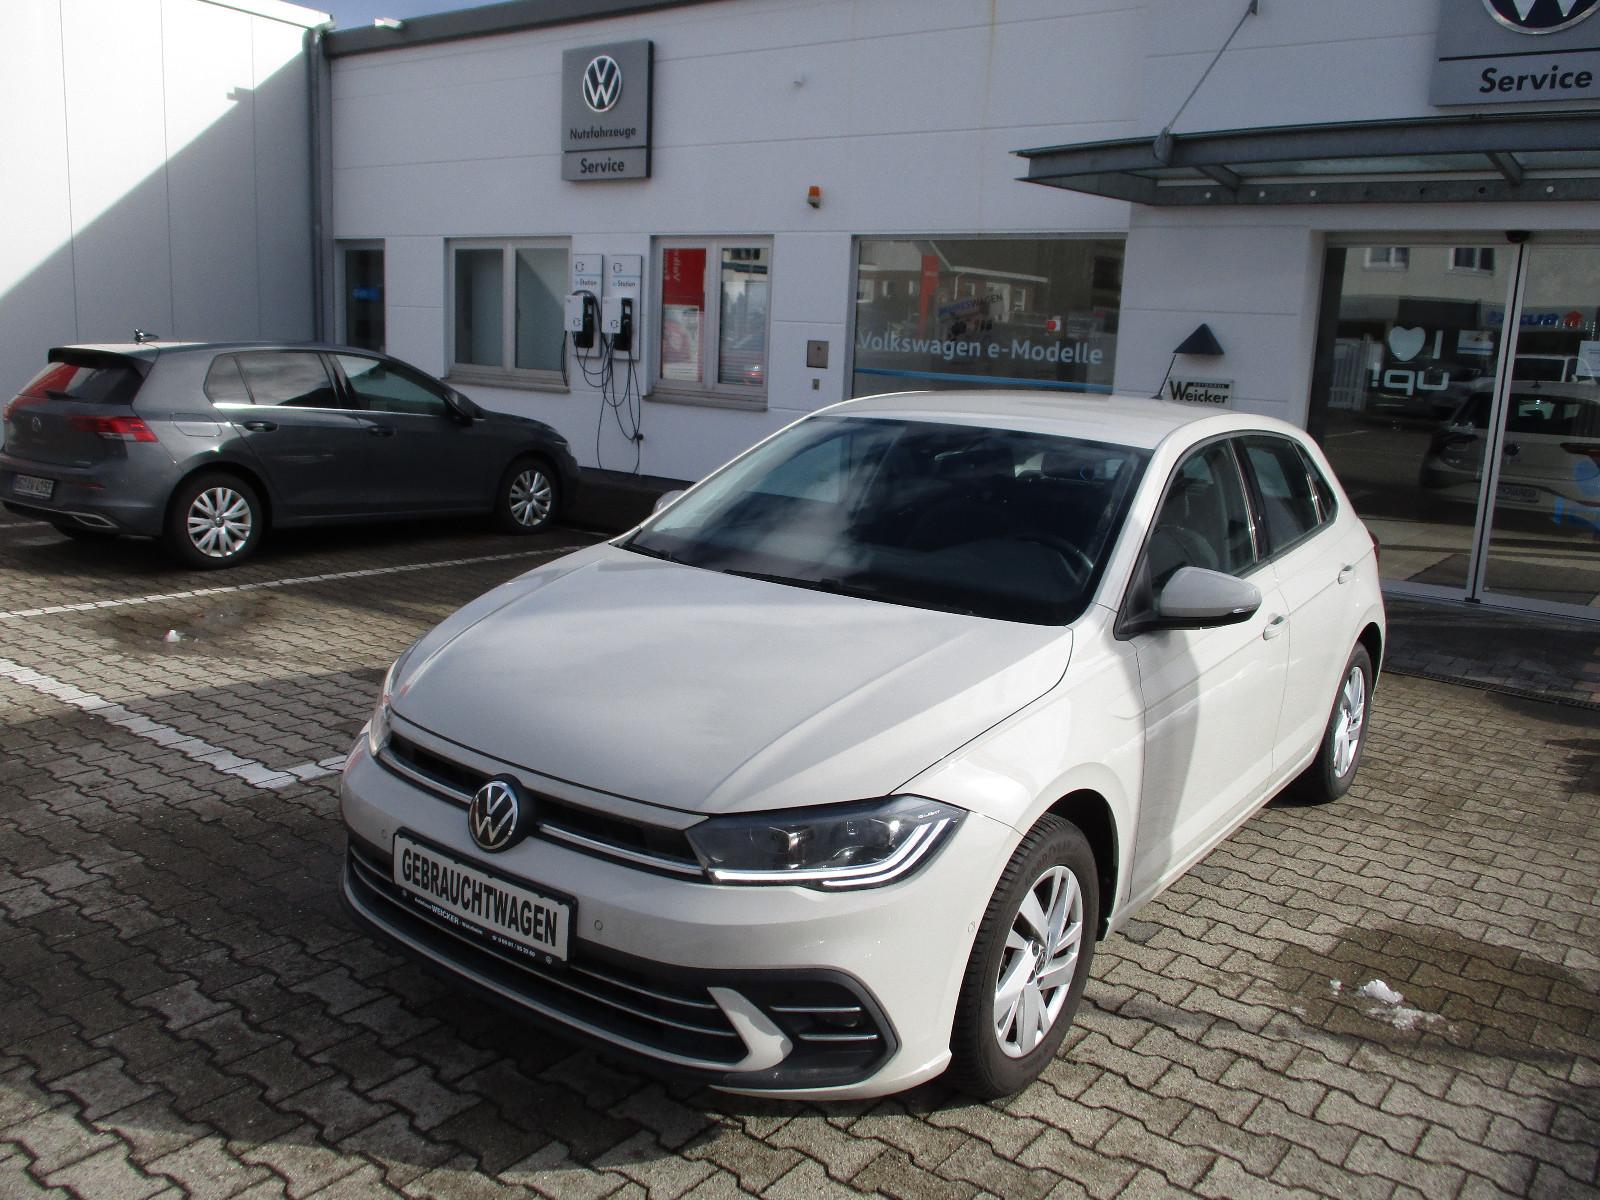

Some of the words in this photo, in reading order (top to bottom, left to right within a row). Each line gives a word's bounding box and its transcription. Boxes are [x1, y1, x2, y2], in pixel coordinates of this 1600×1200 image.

[1479, 65, 1593, 93] Service
[570, 126, 637, 140] Nutzfahrzeuge
[580, 157, 625, 174] Service
[858, 331, 981, 360] Volkswagen
[987, 339, 1104, 365] e-Modelle
[1169, 380, 1229, 404] Weicker
[402, 848, 558, 947] GEBRAUCHTWAGEN
